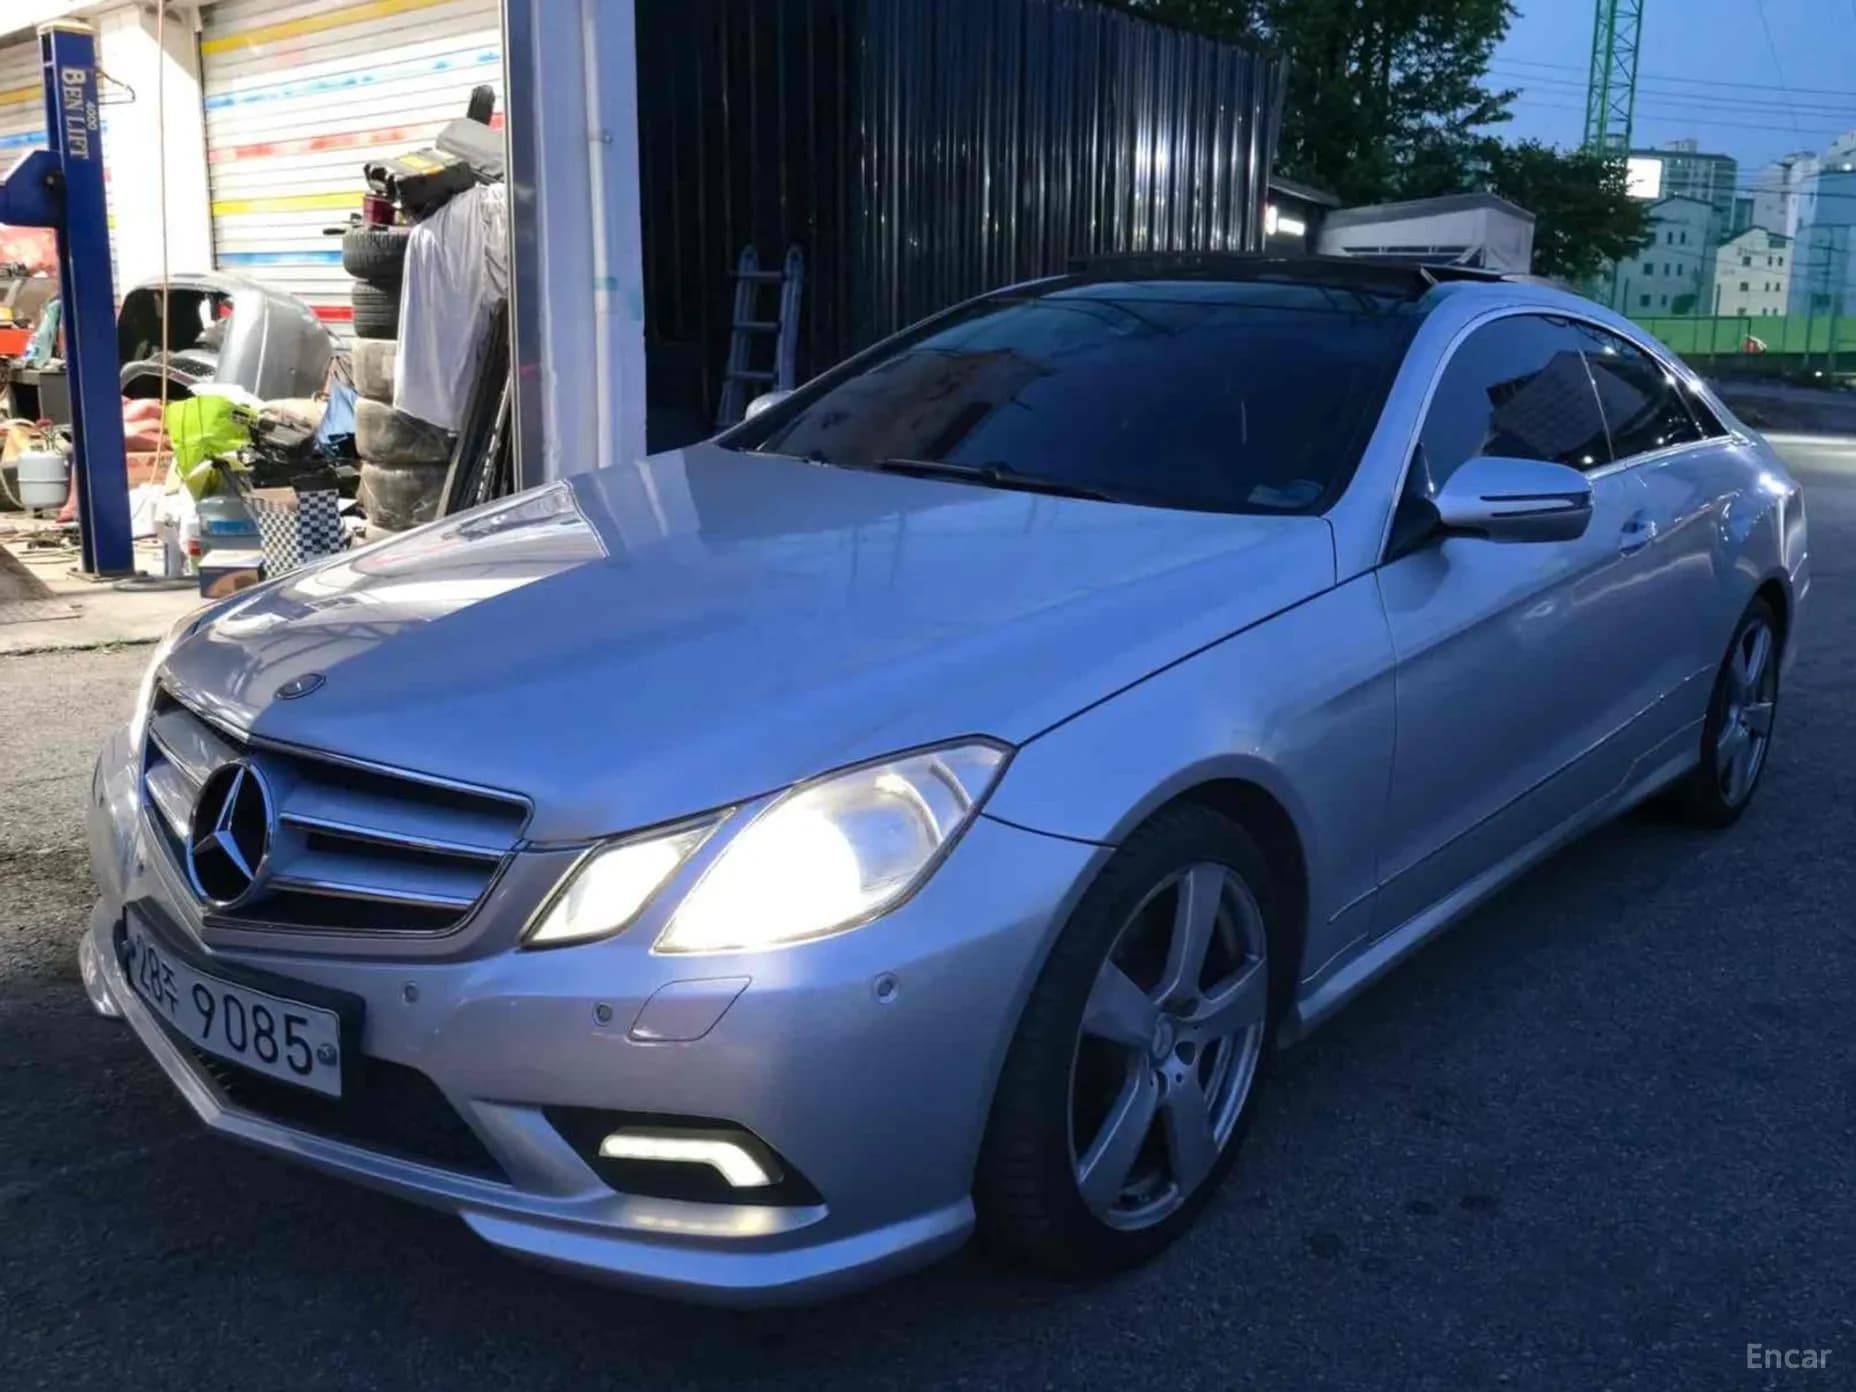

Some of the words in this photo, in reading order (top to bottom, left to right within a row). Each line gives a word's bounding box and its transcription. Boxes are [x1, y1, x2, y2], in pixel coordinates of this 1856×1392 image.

[62, 67, 86, 110] BEN
[66, 116, 89, 160] LIFT
[191, 982, 313, 1075] 9085
